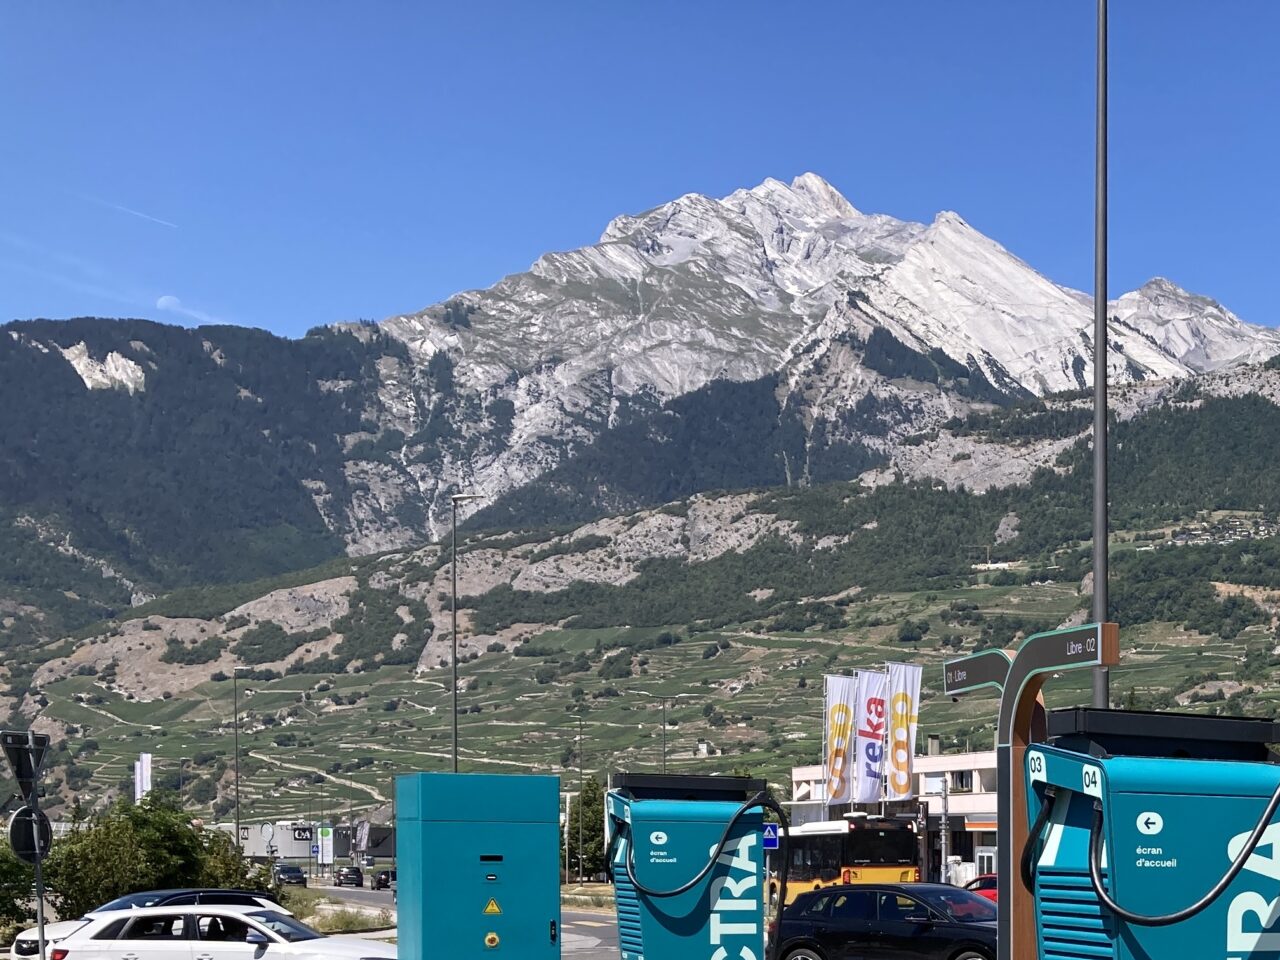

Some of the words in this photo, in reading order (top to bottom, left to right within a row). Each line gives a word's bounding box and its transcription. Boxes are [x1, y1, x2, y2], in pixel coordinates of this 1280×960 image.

[1066, 641, 1083, 656] Libre
[1085, 637, 1096, 652] 02
[947, 672, 953, 683] 01
[954, 670, 967, 682] Libre
[857, 697, 885, 779] reka
[890, 692, 918, 795] coop
[1029, 756, 1042, 773] 03
[1083, 771, 1098, 788] 04
[650, 849, 667, 857] écran
[1135, 845, 1163, 855] écran
[1135, 857, 1177, 868] d'accueil
